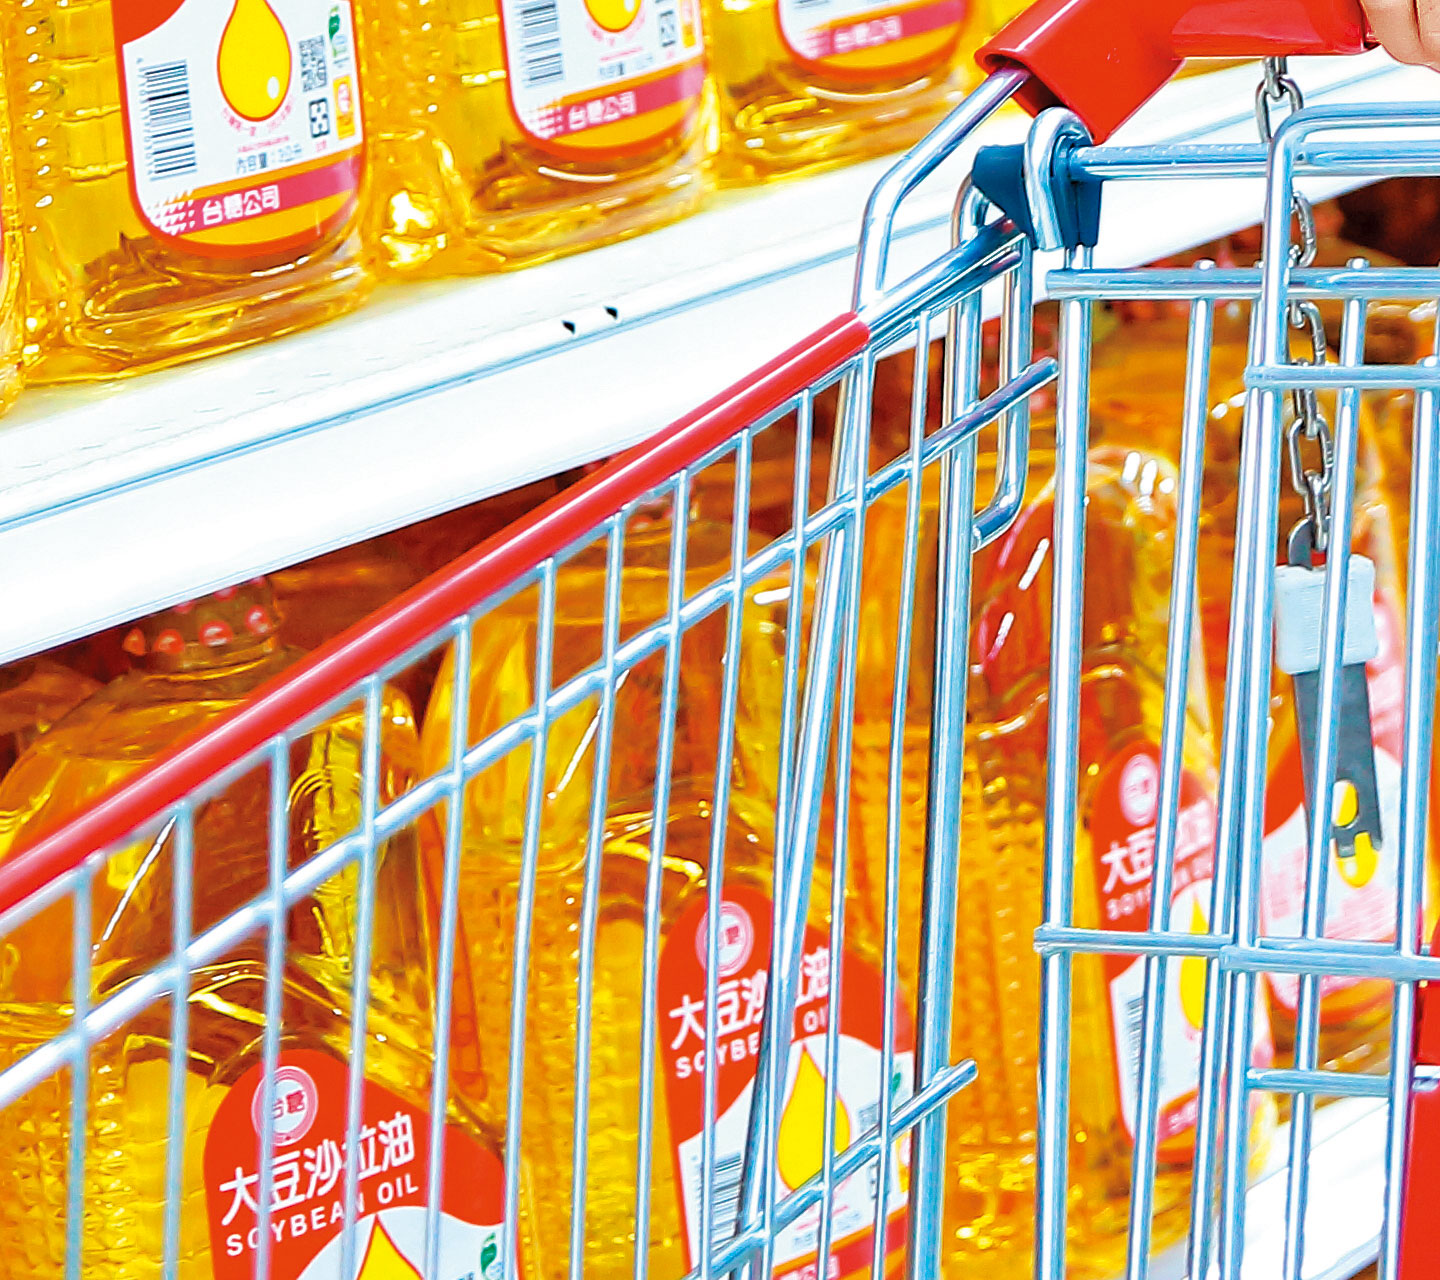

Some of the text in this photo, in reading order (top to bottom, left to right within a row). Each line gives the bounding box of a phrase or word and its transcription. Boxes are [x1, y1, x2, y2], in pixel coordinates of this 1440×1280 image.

[201, 185, 281, 226] 台糖公司
[669, 946, 830, 1051] 大豆沙油
[377, 1173, 419, 1206] OIL
